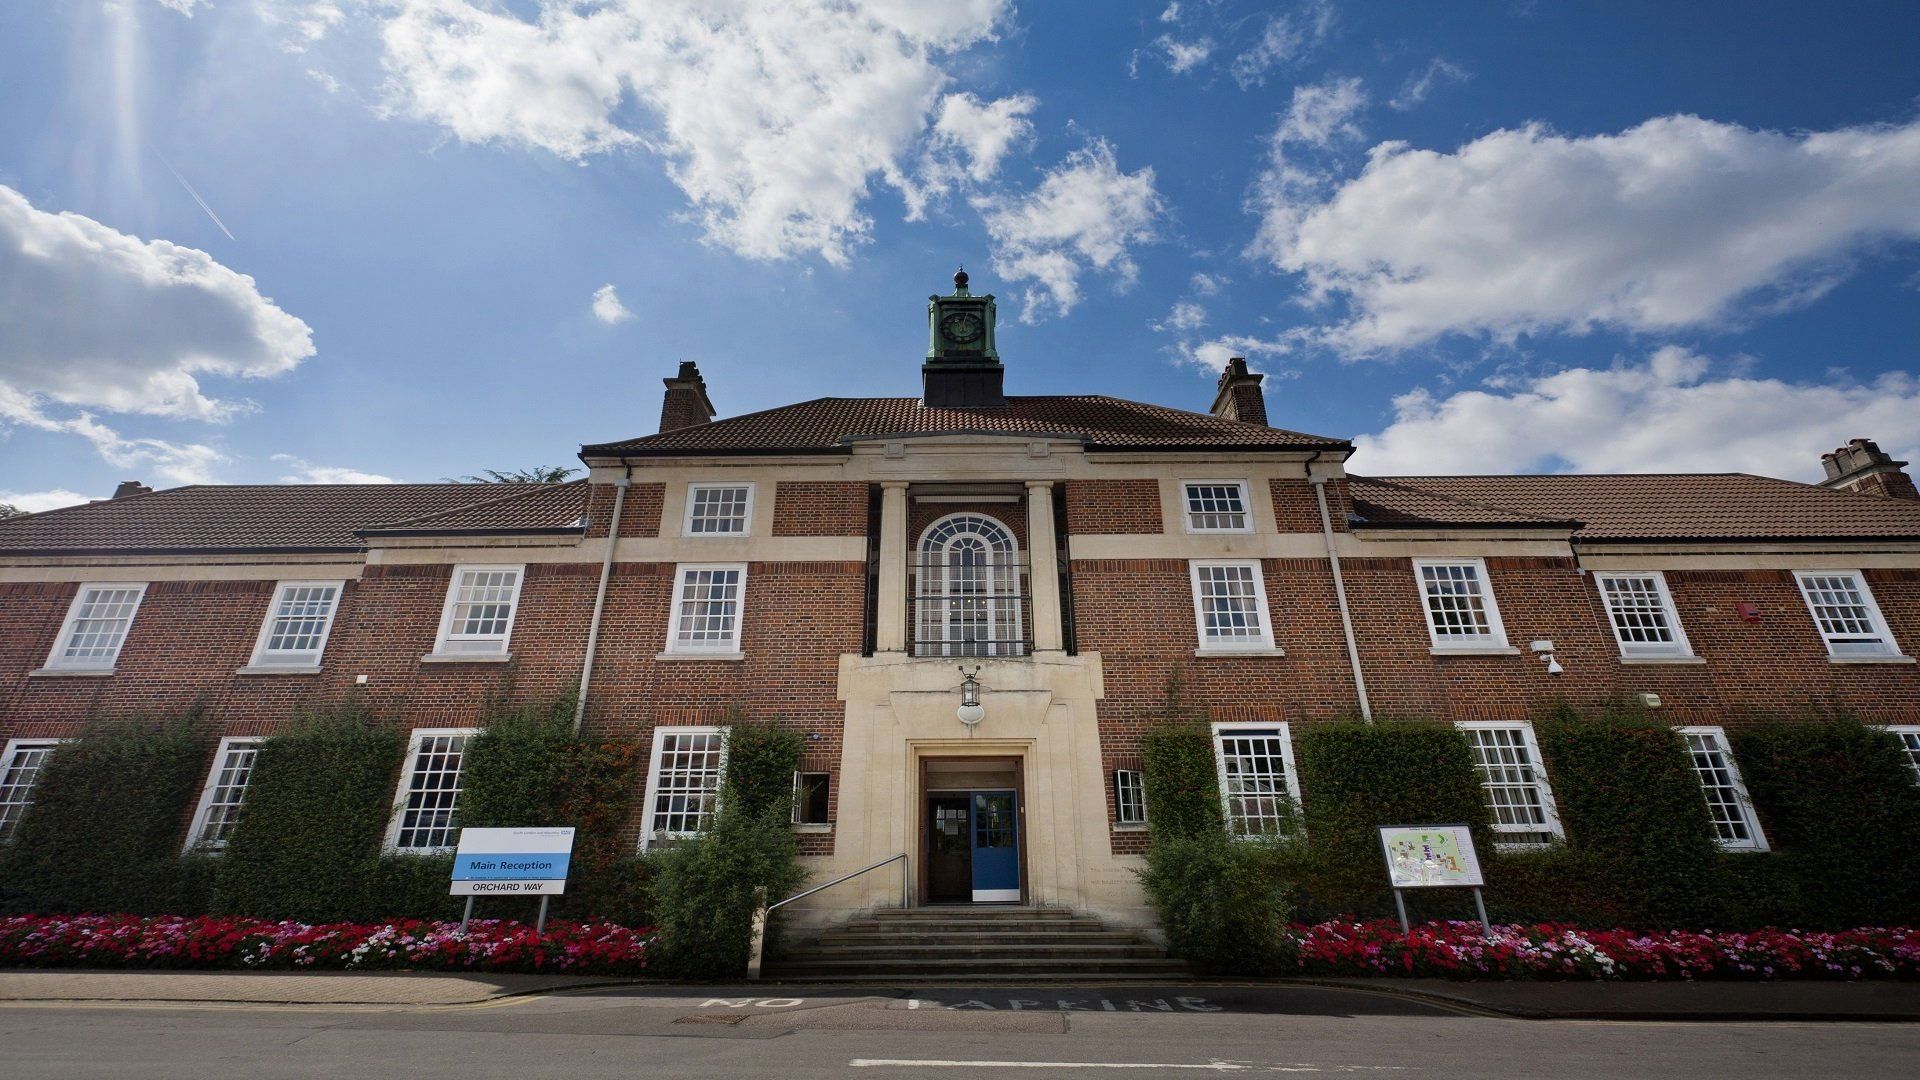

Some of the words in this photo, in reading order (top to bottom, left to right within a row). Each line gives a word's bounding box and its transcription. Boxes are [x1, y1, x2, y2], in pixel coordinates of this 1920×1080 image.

[470, 861, 496, 870] Main
[500, 860, 552, 871] Reception
[472, 883, 520, 891] ORCHARD
[524, 883, 544, 891] WAY
[698, 998, 804, 1008] NO
